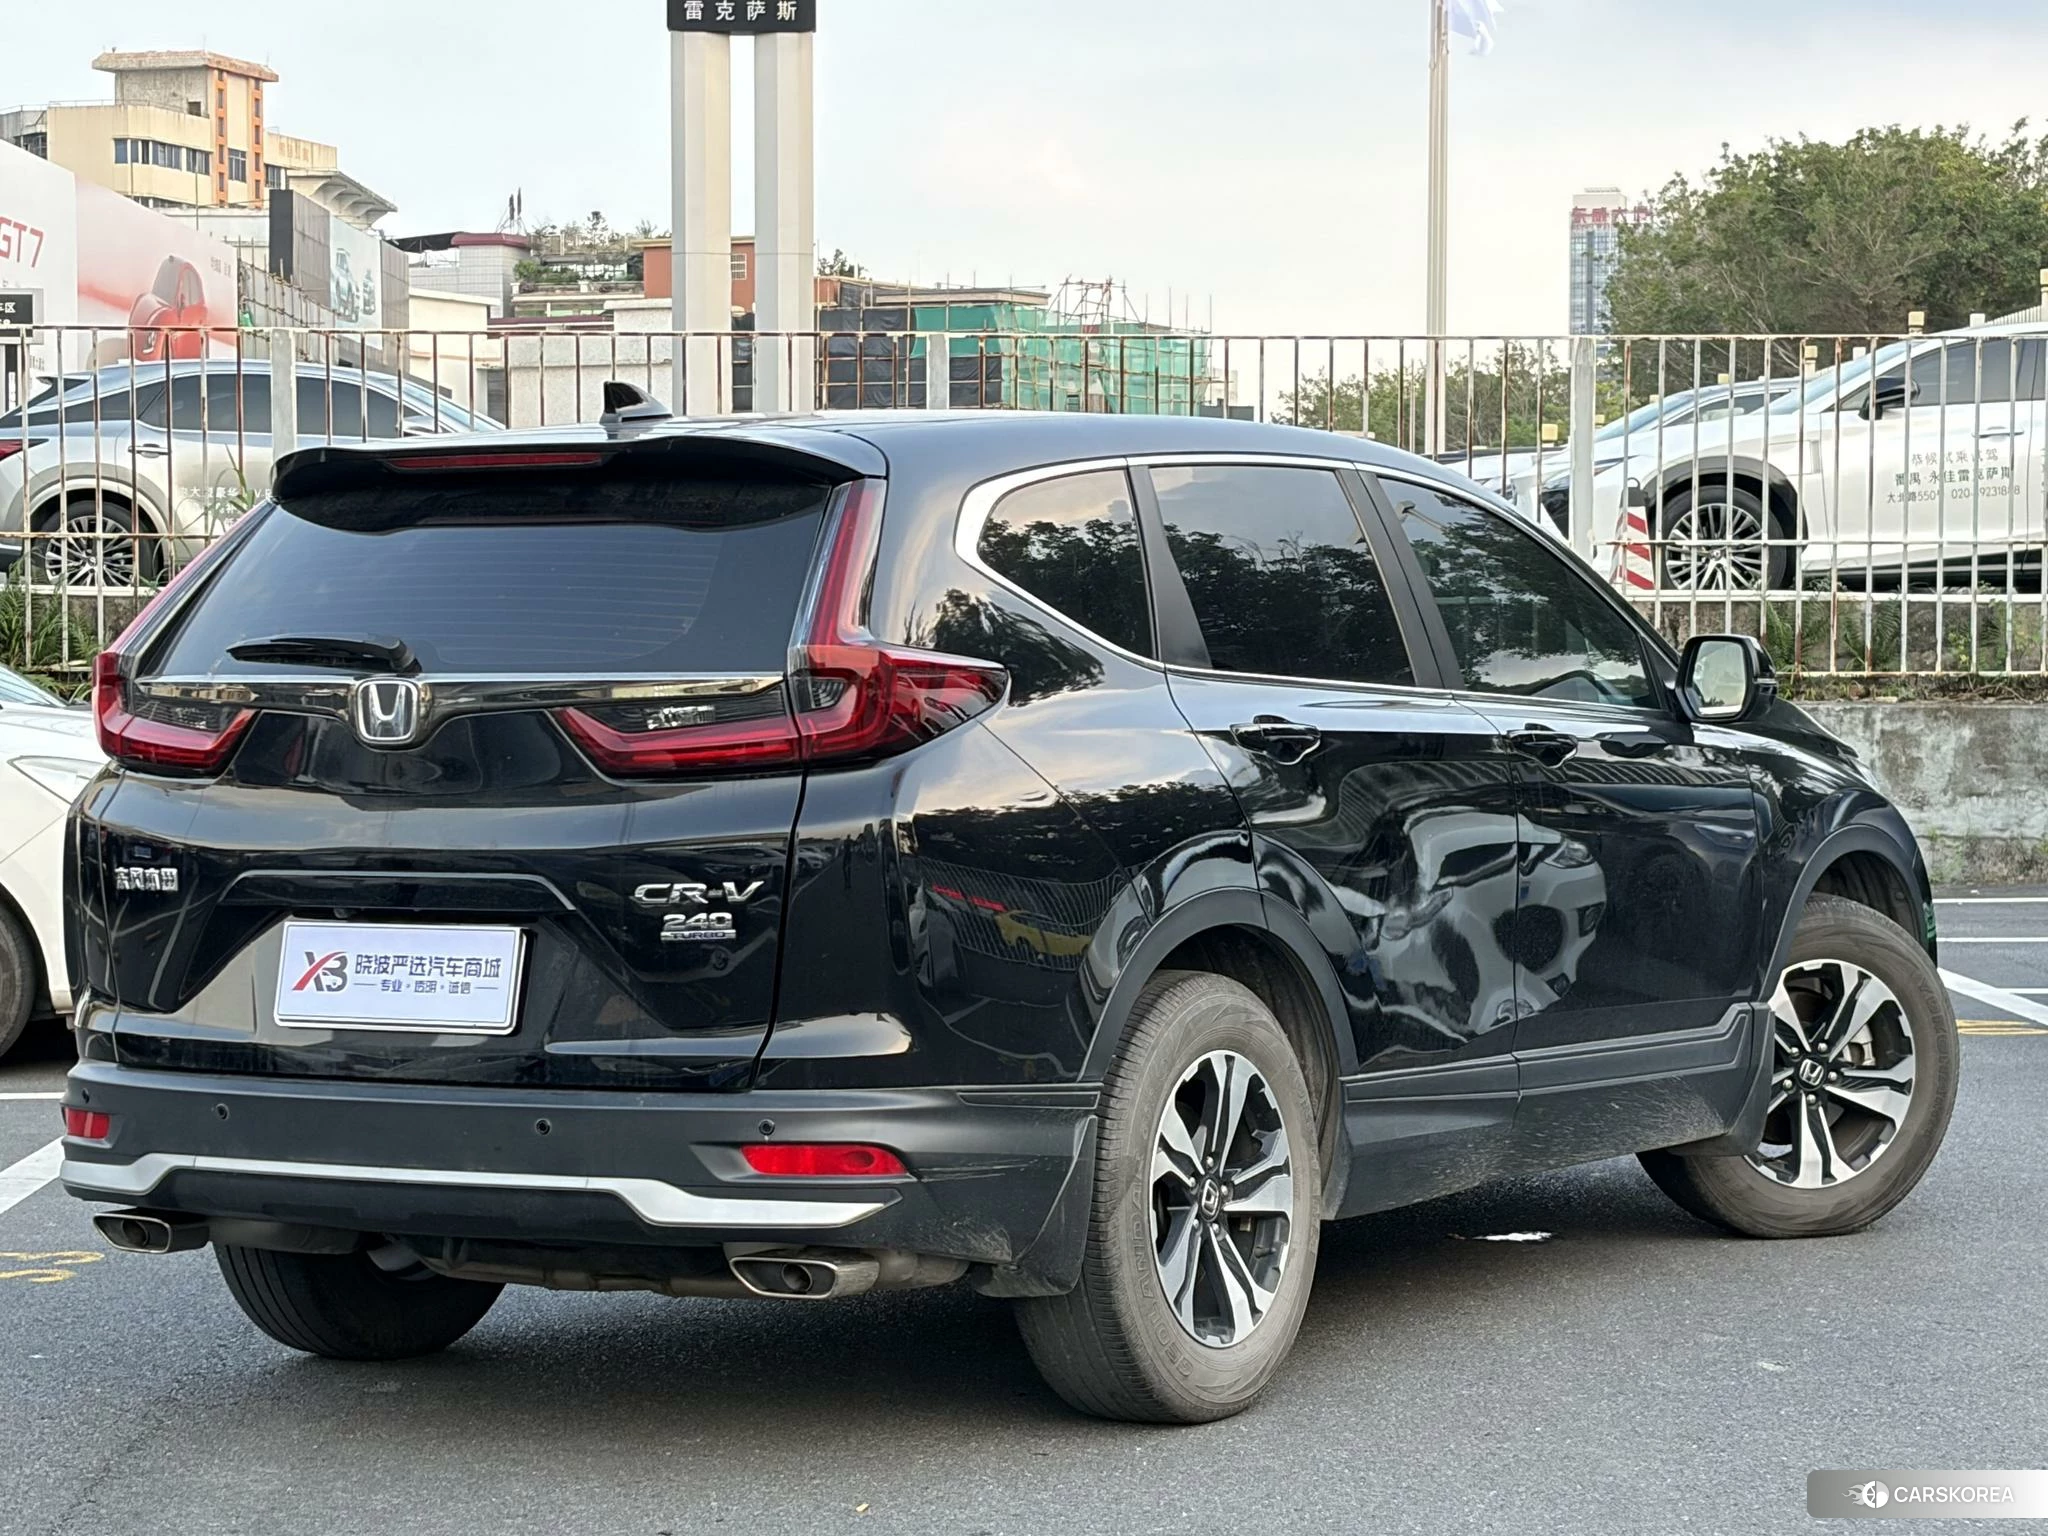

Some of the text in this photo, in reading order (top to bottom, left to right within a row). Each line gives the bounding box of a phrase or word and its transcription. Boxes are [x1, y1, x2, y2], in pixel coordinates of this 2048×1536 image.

[683, 0, 798, 21] 雷克萨斯
[0, 216, 44, 268] GT7
[114, 867, 179, 892] 东风本田
[634, 880, 765, 904] CR-V
[663, 911, 733, 931] 240
[670, 930, 727, 940] TURBO
[354, 953, 502, 978] 晓波严选汽车商城
